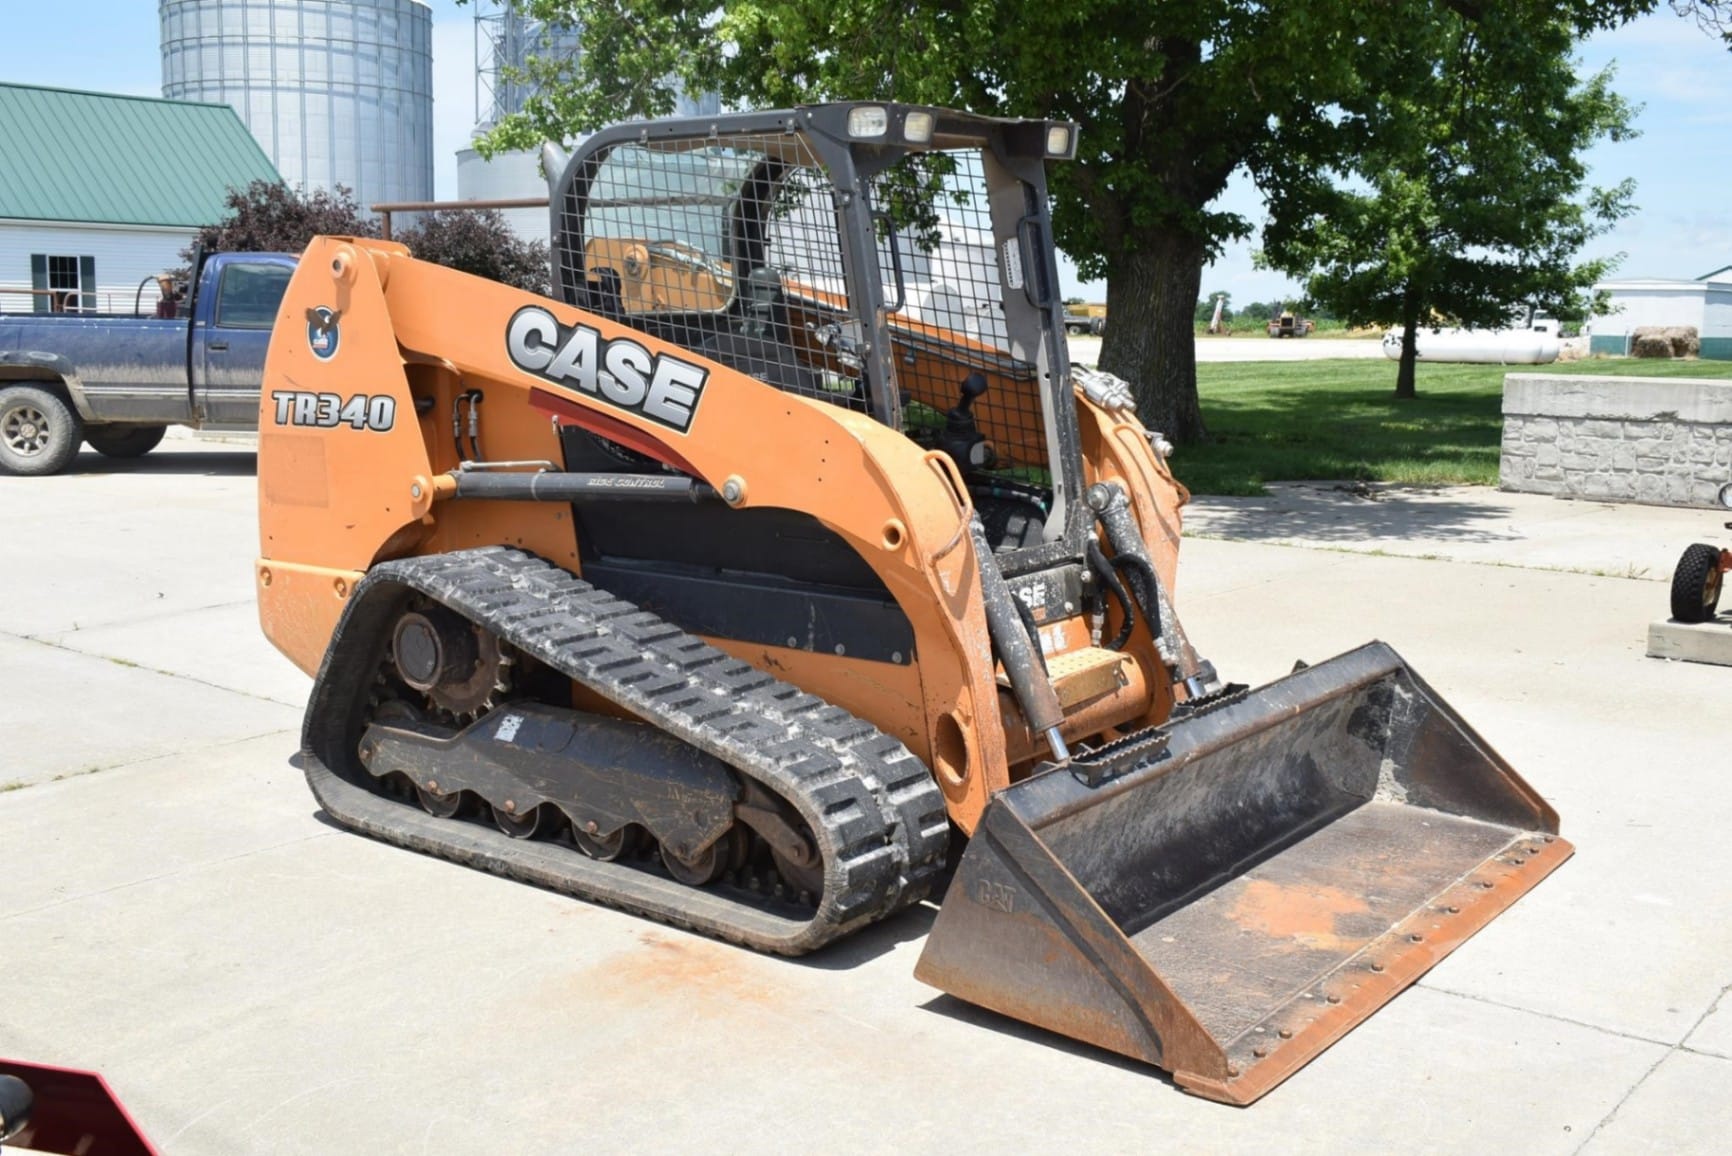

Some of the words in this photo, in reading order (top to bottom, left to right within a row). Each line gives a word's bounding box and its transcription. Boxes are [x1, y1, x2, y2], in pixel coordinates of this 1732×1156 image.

[507, 306, 708, 429] CASE
[272, 390, 396, 431] TR340
[615, 478, 665, 489] CONTROL
[1011, 582, 1047, 608] SE
